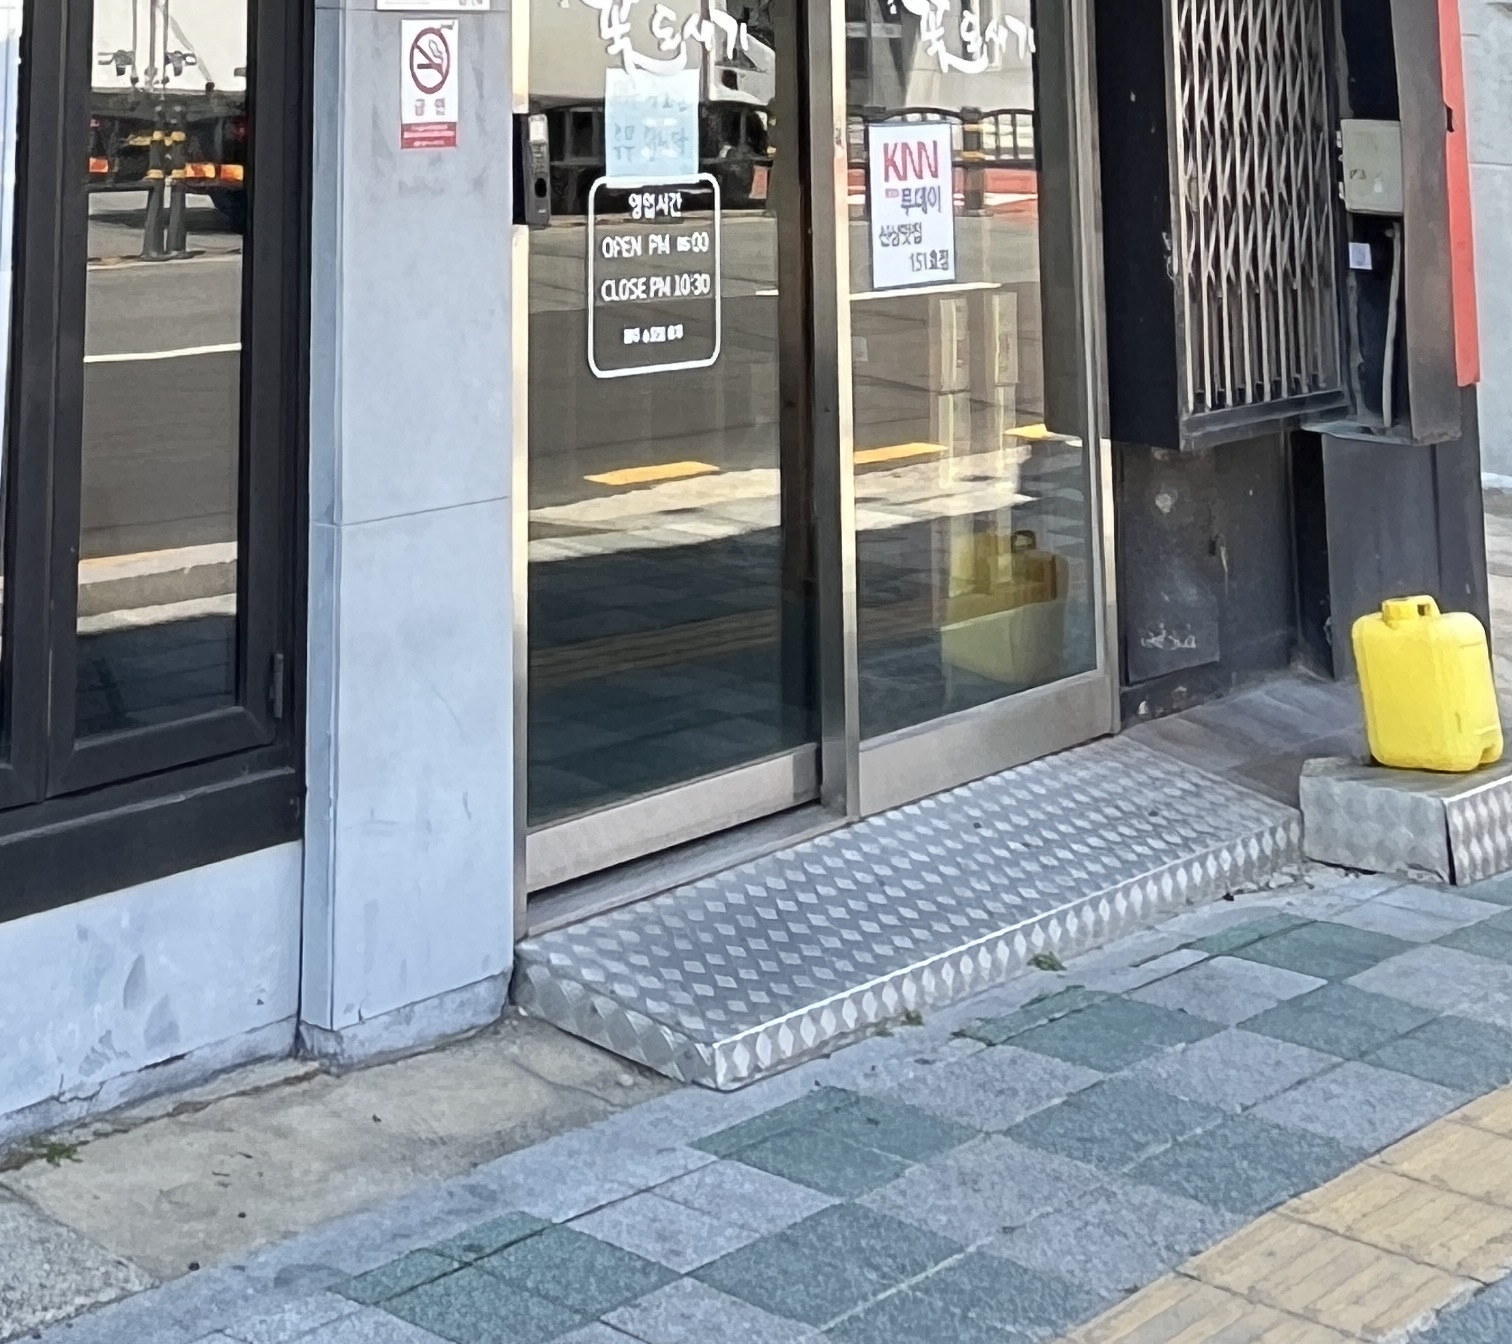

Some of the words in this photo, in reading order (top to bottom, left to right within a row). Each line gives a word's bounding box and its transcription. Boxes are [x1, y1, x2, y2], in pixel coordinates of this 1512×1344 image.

[883, 140, 939, 183] KNN
[628, 192, 683, 220] 영업시간
[602, 235, 642, 259] OPEN
[648, 233, 670, 255] PM
[601, 276, 648, 302] CLOSE
[649, 275, 672, 298] PM
